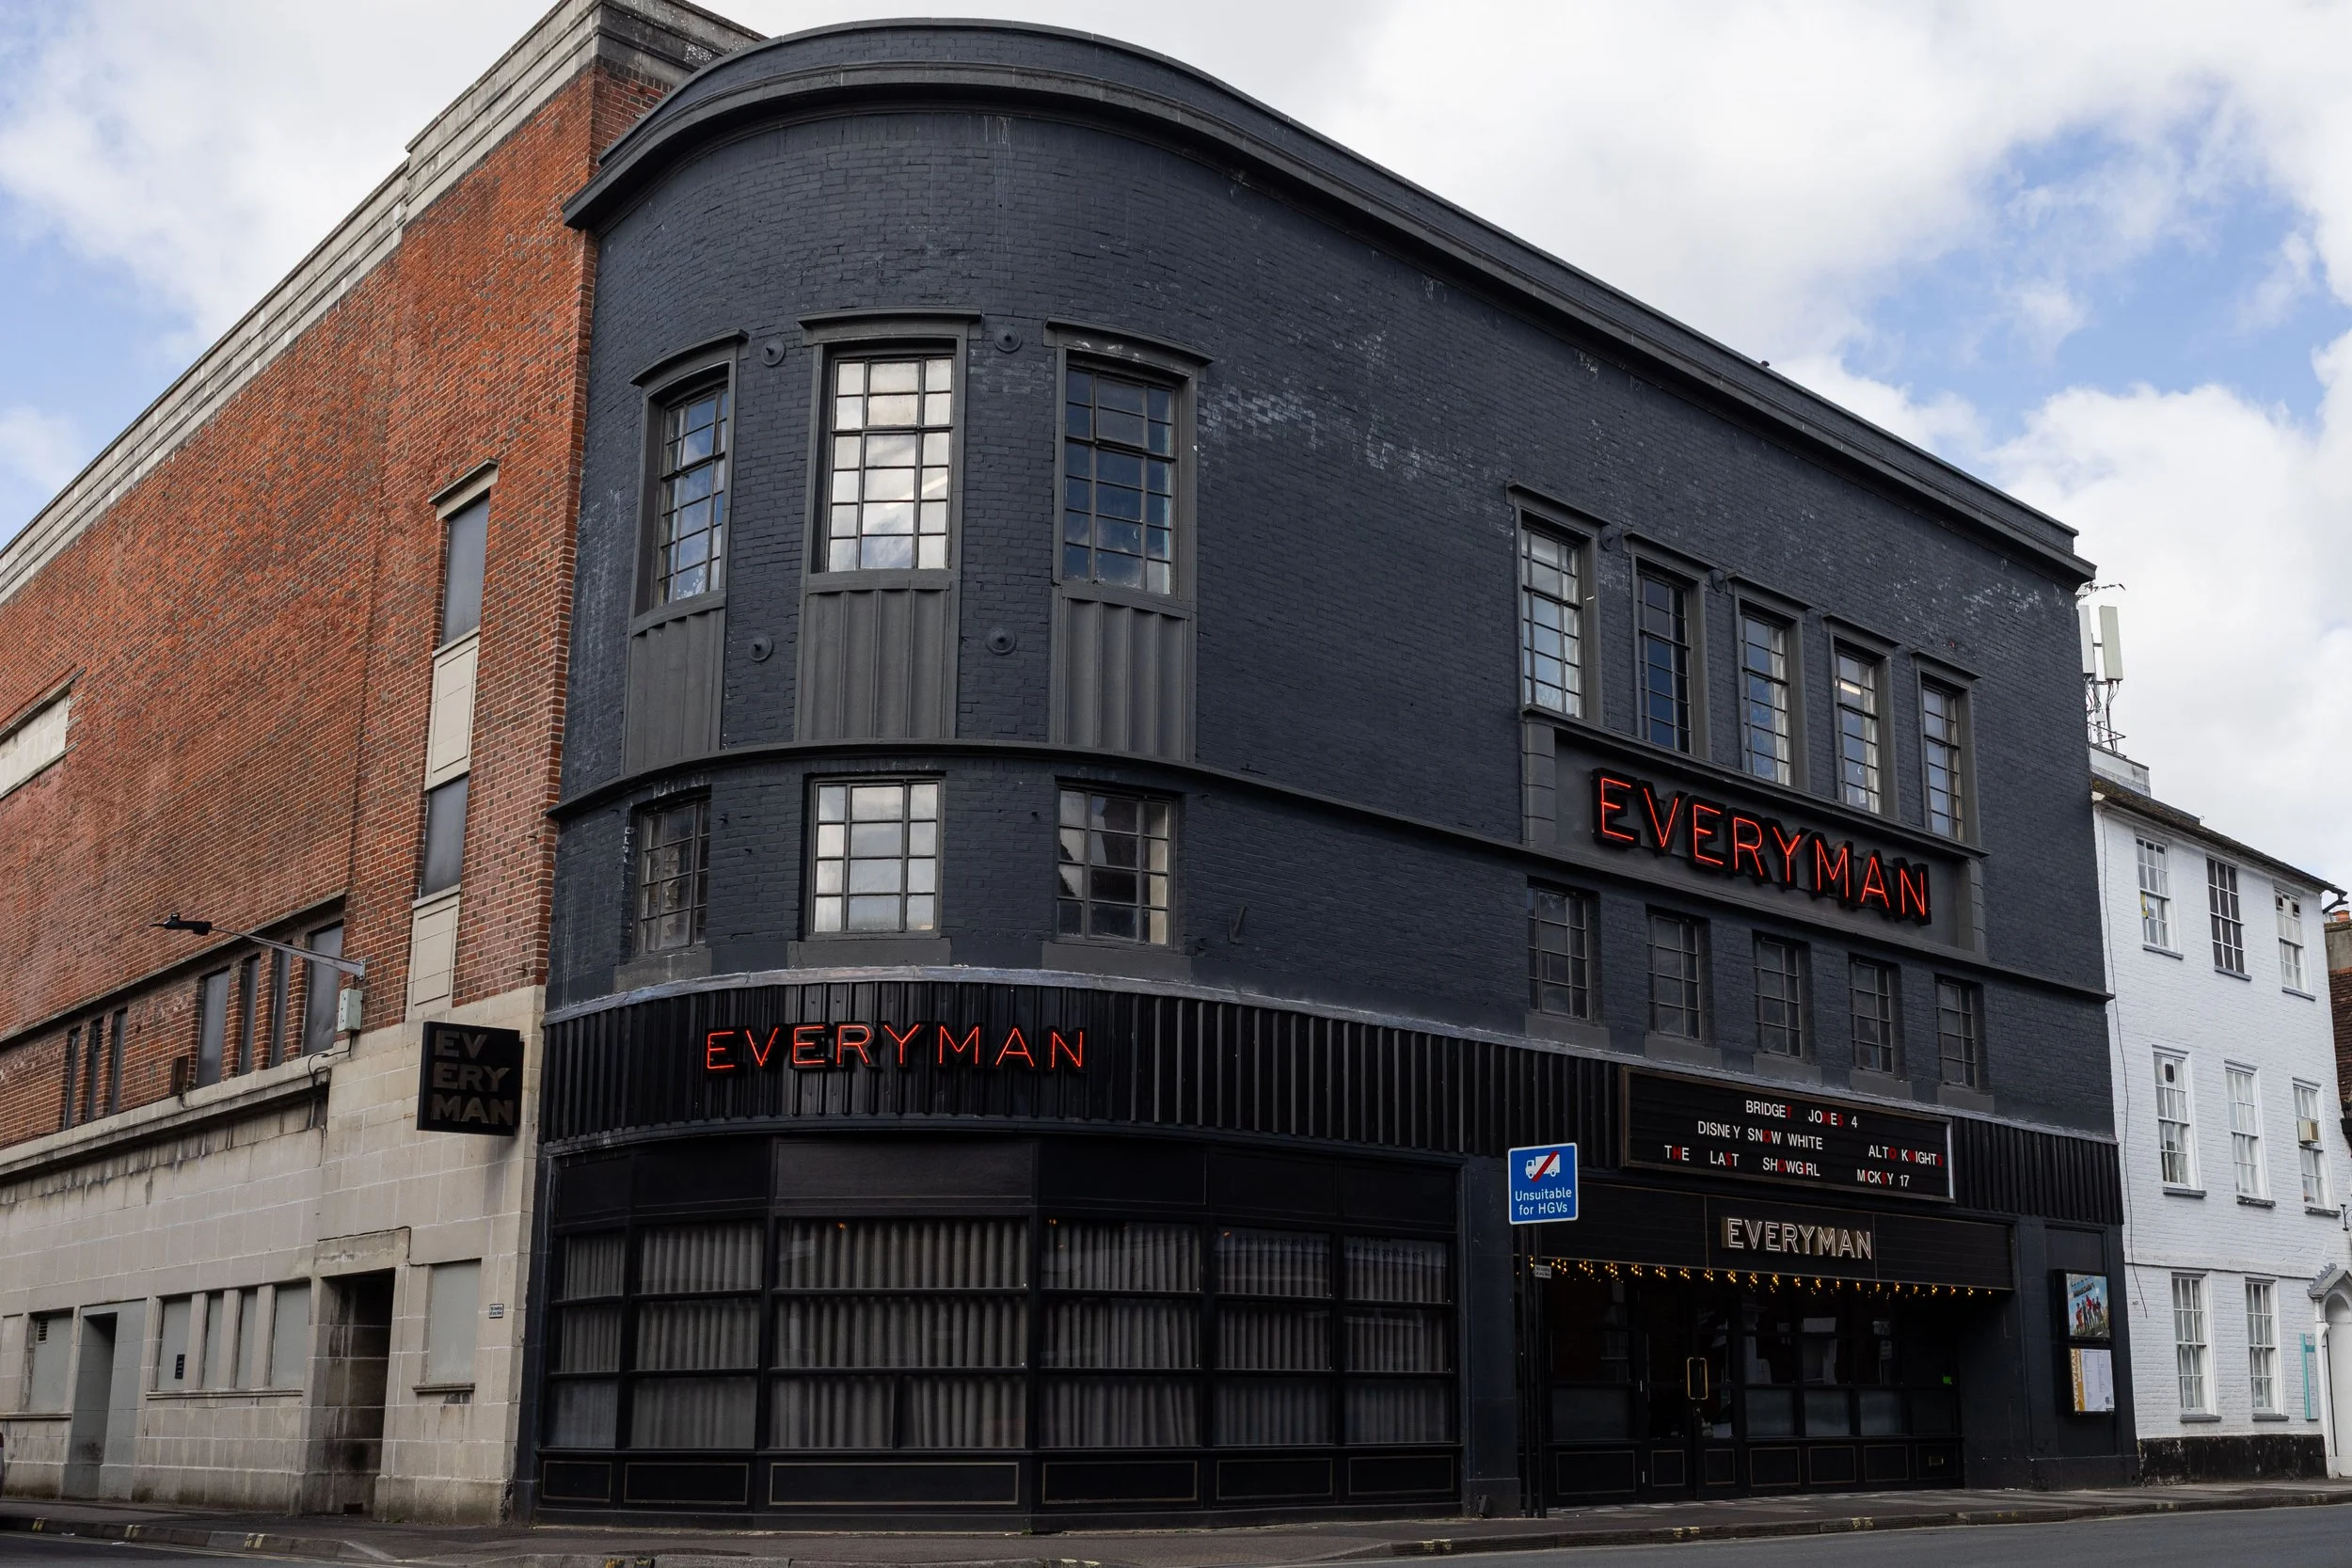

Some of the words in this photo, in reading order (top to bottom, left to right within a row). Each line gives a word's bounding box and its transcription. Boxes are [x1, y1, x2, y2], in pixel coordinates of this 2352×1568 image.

[1593, 768, 1931, 926] EVERYMAN
[434, 1029, 488, 1059] EV
[706, 1022, 1087, 1072] EVERYMAN
[433, 1061, 511, 1091] ERY
[430, 1093, 514, 1125] MAN
[1745, 1100, 1792, 1119] BRIDGET
[1808, 1108, 1844, 1128] JONES
[1851, 1116, 1858, 1129] 4
[1697, 1120, 1740, 1140] DISNEY
[1747, 1127, 1782, 1145] SNOW
[1788, 1132, 1823, 1150] WHITE
[1664, 1145, 1690, 1162] THE
[1709, 1150, 1740, 1167] LAST
[1762, 1157, 1820, 1177] SHOWGIRL
[1868, 1144, 1898, 1161] ALTO
[1901, 1149, 1944, 1167] KNIGHTS
[1857, 1168, 1894, 1186] MICKEY
[1899, 1175, 1910, 1188] 17
[1515, 1187, 1572, 1202] Unsuitable
[1519, 1205, 1534, 1215] for
[1538, 1201, 1568, 1214] HGVs
[1723, 1217, 1872, 1259] EVERYMAN
